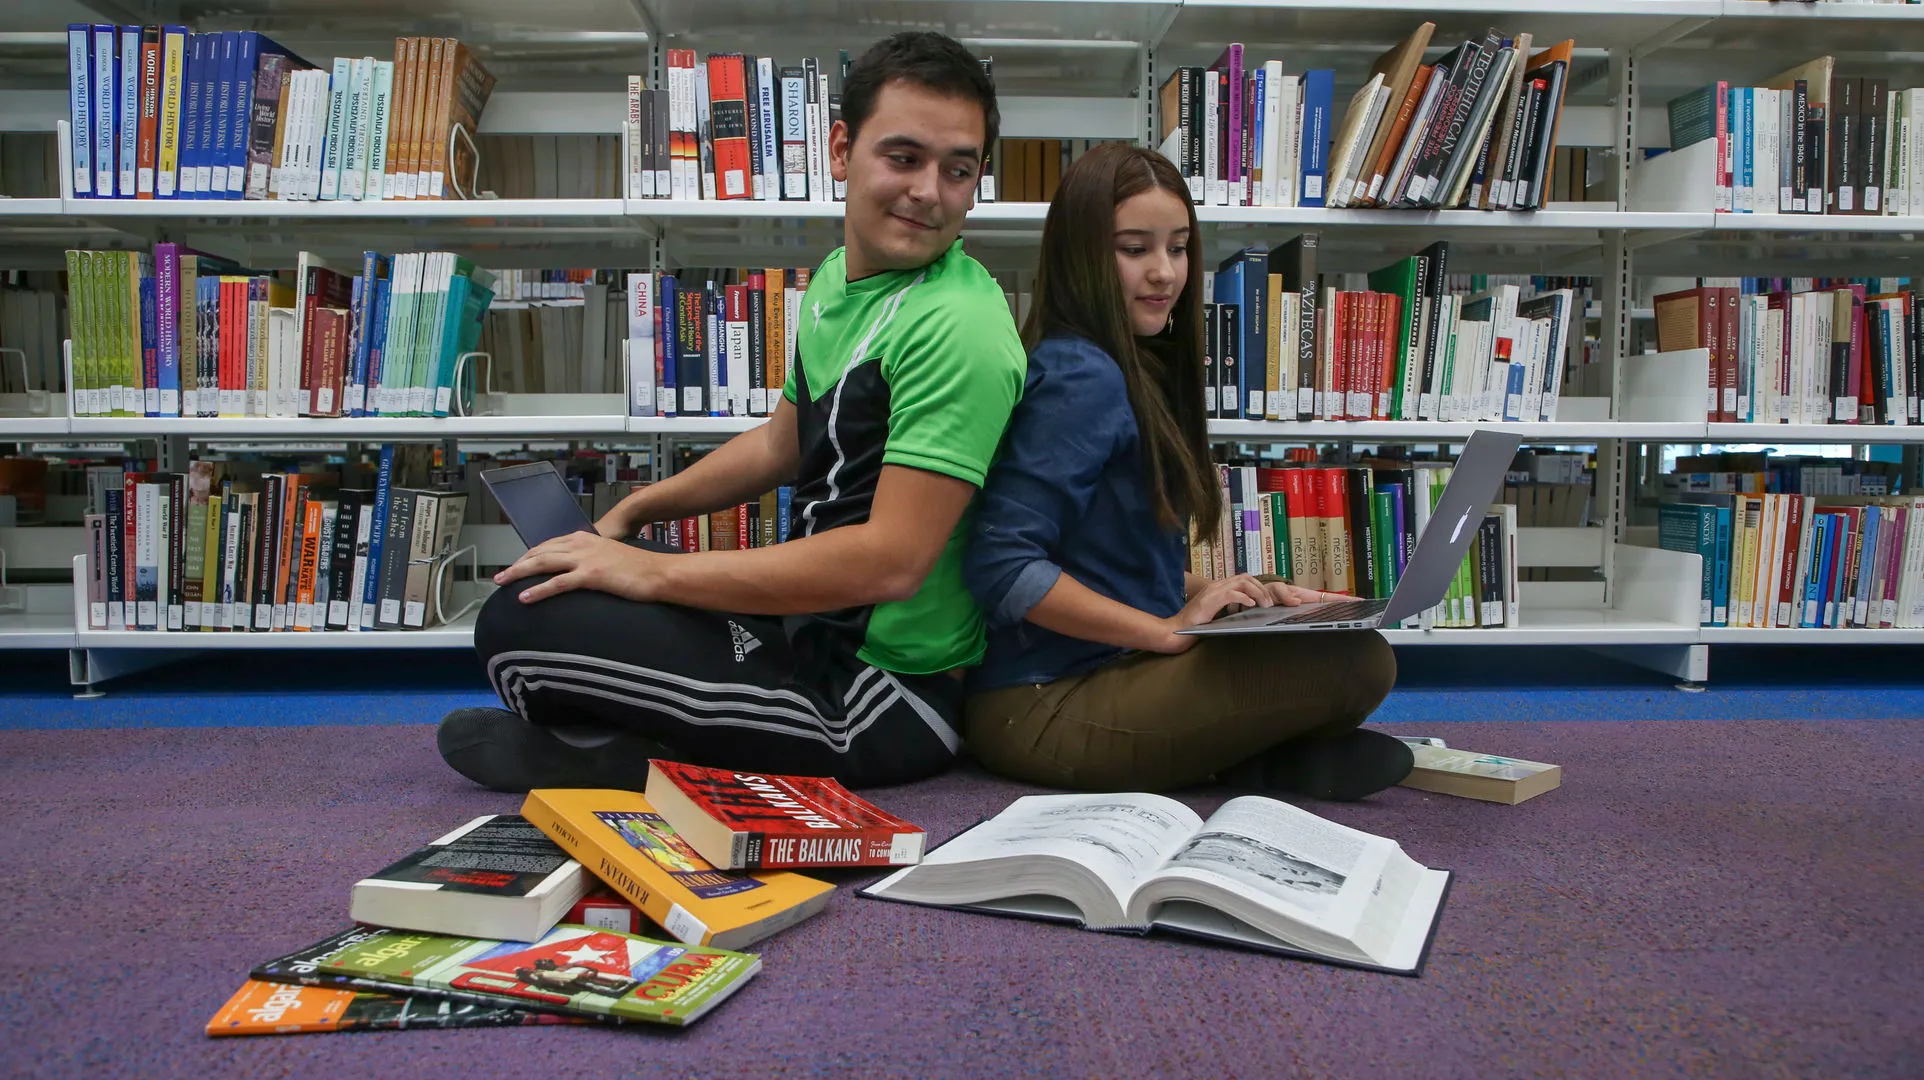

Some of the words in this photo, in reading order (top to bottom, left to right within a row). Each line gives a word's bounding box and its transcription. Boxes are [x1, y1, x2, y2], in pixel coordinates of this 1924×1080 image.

[146, 49, 156, 86] WORLD
[78, 74, 87, 108] WORLD
[102, 76, 111, 109] WORLD
[127, 76, 136, 109] WORLD
[168, 75, 177, 109] WORLD
[190, 82, 199, 114] HISTORIA
[204, 82, 214, 113] HISTORIA
[219, 81, 229, 113] HISTORIA
[237, 81, 247, 112] HISTORIA
[630, 82, 639, 95] THE
[762, 87, 770, 106] FREE
[1442, 50, 1494, 154] TEOTIHUACAN
[330, 90, 343, 133] UNIVERSAL
[348, 91, 360, 134] UNIVERSAL
[374, 92, 385, 135] UNIVERSAL
[630, 98, 640, 124] ARABS
[788, 81, 799, 136] SHARON
[1516, 108, 1524, 120] ART
[1798, 93, 1806, 122] MEXICO
[78, 110, 87, 148] HISTORY
[102, 111, 111, 149] HISTORY
[126, 112, 135, 150] HISTORY
[165, 111, 175, 150] HISTORY
[763, 109, 772, 157] JERUSALEM
[1515, 121, 1521, 129] OF
[1798, 123, 1805, 131] in
[327, 134, 338, 168] HISTORIA
[345, 135, 355, 170] HISTORIA
[372, 135, 382, 171] HISTORIA
[1506, 128, 1520, 173] MESOAMERICA
[164, 254, 172, 294] MODERN
[638, 282, 647, 317] CHINA
[686, 292, 694, 321] Steppes
[1413, 289, 1421, 317] BRONCO
[693, 305, 701, 331] Empire
[1301, 286, 1316, 360] AZTECAS
[165, 330, 173, 369] HISTORY
[686, 326, 694, 351] History
[731, 324, 745, 360] Japan
[772, 339, 780, 364] African
[772, 365, 780, 389] History
[1408, 347, 1416, 383] MONCADA
[1726, 367, 1735, 386] VILLA
[392, 496, 402, 510] the
[109, 515, 117, 525] The
[323, 518, 332, 539] GHOST
[389, 513, 400, 537] ashes
[399, 516, 411, 538] from
[764, 517, 773, 536] THE
[1234, 510, 1243, 536] Historia
[303, 536, 316, 566] WAR
[320, 539, 330, 570] SOLDIERS
[1236, 538, 1242, 546] de
[111, 576, 119, 593] World
[728, 620, 744, 662] adidas
[733, 773, 841, 829] BALKANS
[769, 838, 796, 863] THE
[798, 838, 862, 863] BALKANS
[599, 857, 651, 905] RAMAYANA
[355, 936, 430, 967] algar
[634, 953, 726, 1002] CUBA
[247, 982, 304, 1022] algar
